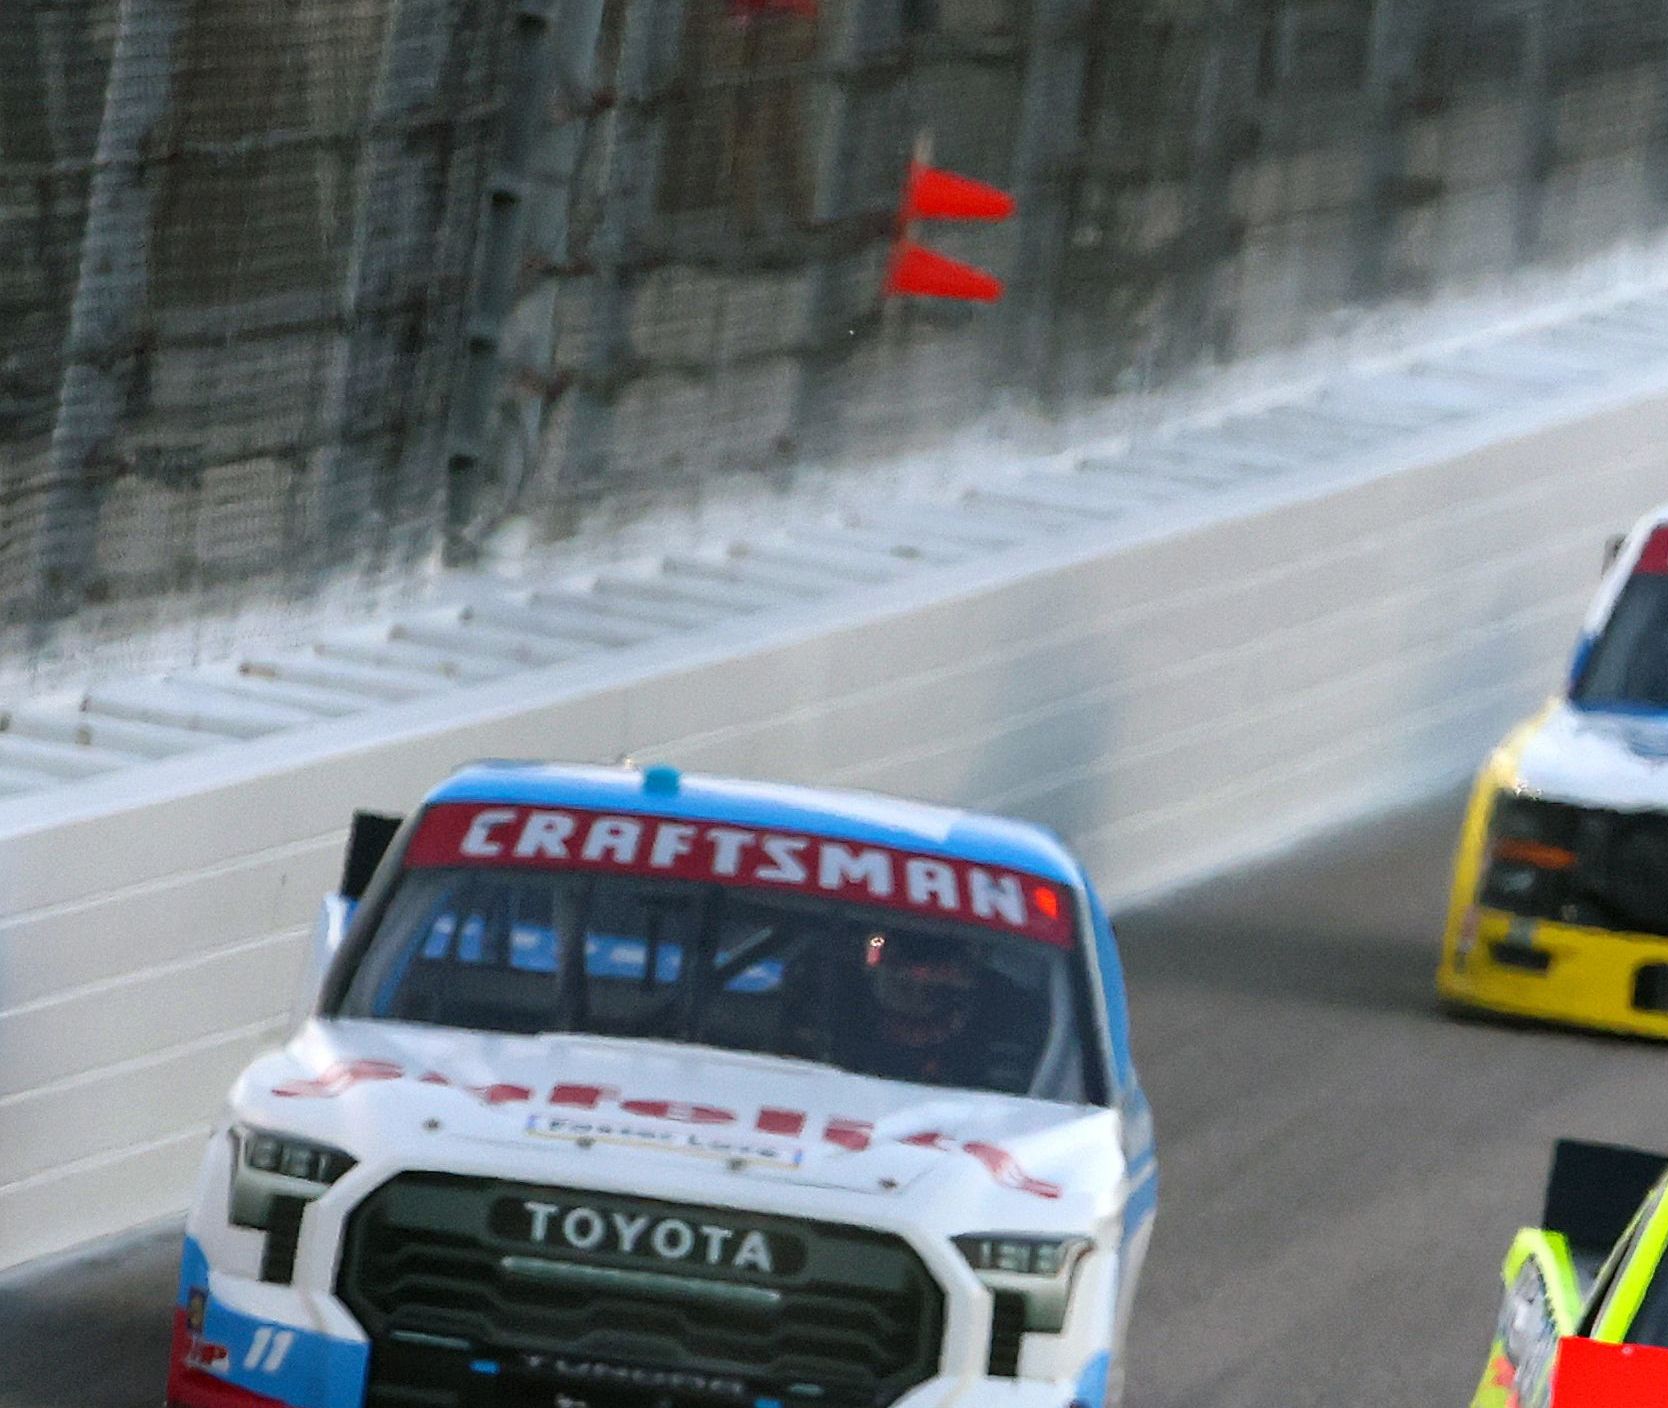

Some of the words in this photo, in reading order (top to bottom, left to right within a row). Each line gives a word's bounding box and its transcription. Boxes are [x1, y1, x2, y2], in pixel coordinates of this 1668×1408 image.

[460, 808, 1028, 926] CRAFTSMAN
[524, 1201, 774, 1273] TOYOTA
[243, 1326, 296, 1375] 11
